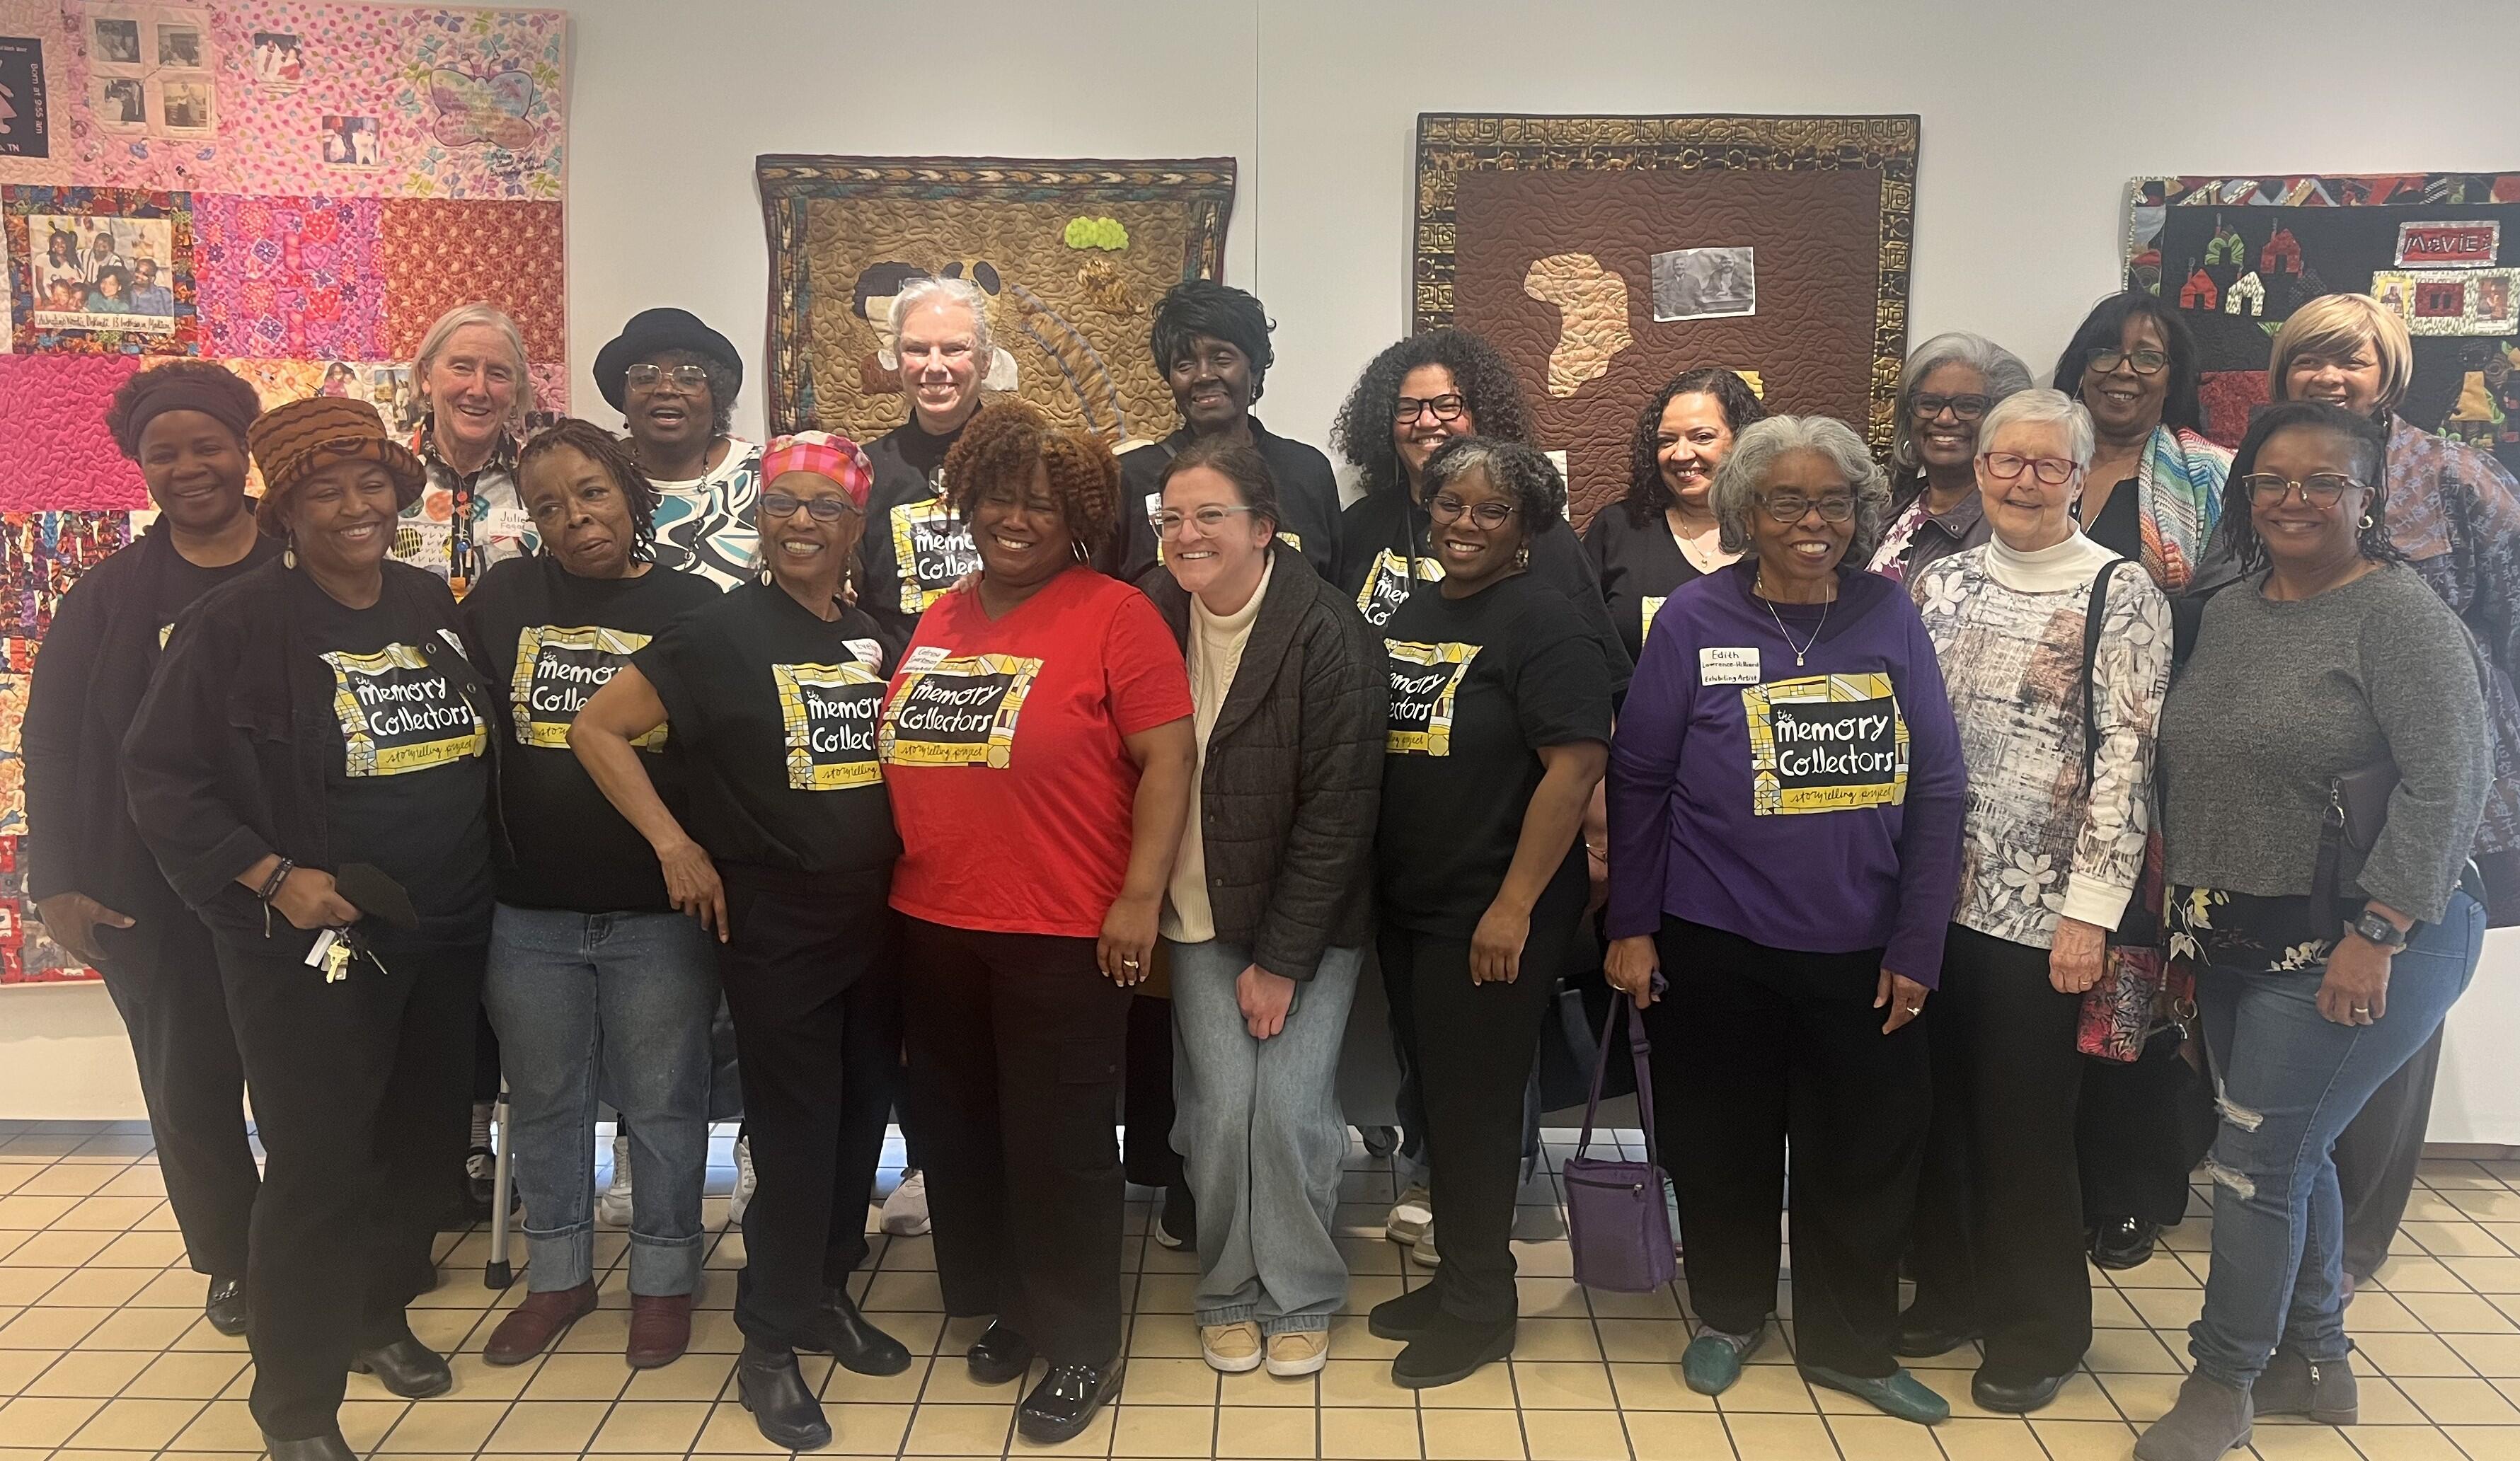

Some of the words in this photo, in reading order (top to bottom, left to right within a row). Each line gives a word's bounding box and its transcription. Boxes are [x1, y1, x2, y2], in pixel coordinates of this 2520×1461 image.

[1712, 649, 1739, 659] Edith
[369, 703, 470, 737] Collectors
[899, 705, 993, 733] Collectors
[1776, 708, 1795, 721] the
[386, 744, 442, 763] storytelling
[900, 744, 950, 761] storytelling
[1779, 744, 1894, 777] Collectors
[822, 764, 878, 779] storytelling
[1790, 787, 1857, 804] storytelling
